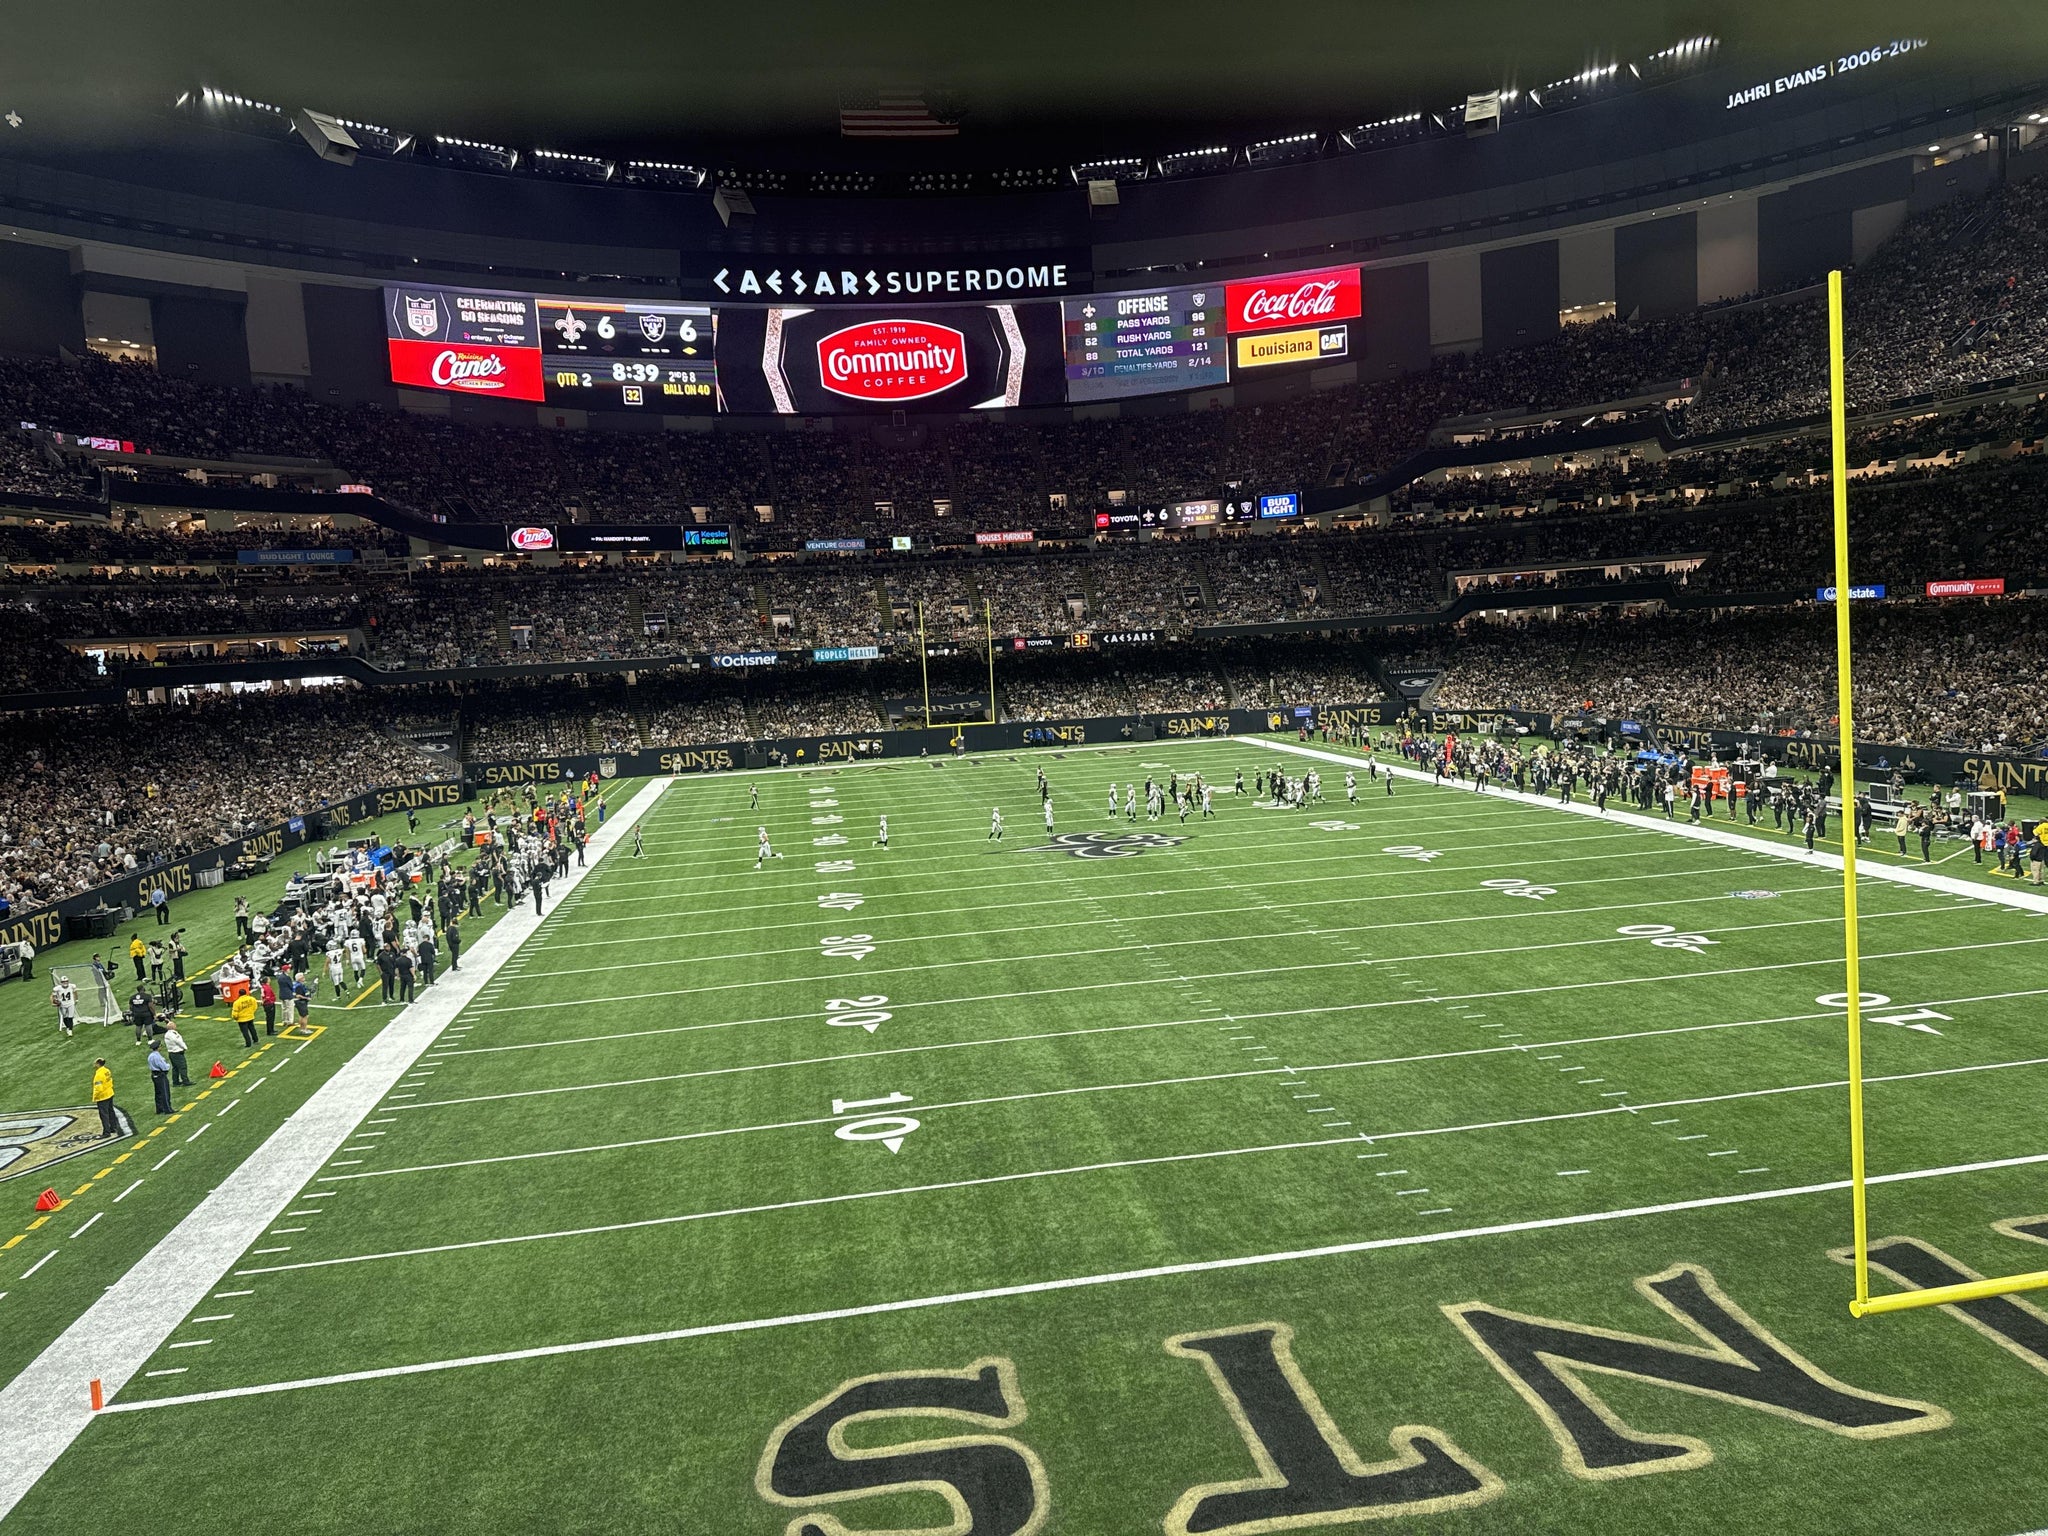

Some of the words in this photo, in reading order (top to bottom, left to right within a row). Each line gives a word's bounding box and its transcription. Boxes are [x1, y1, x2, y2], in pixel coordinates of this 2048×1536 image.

[1726, 82, 1771, 109] JAHRI
[1775, 65, 1827, 94] EVANS
[713, 267, 881, 296] CAESARS
[886, 264, 1067, 294] SUPERDOME
[456, 297, 526, 313] CELEBRATING
[1117, 295, 1169, 315] OFFENSE
[1243, 279, 1341, 323] Coca-Cola
[411, 313, 434, 327] 60
[461, 311, 476, 322] 60
[477, 312, 524, 326] SEASONS
[1117, 319, 1140, 329] PASS
[1141, 315, 1170, 327] YARDS
[597, 315, 616, 339] 6
[679, 319, 697, 342] 6
[873, 327, 888, 335] EST.
[890, 326, 906, 334] 1919
[854, 338, 888, 347] FAMILY
[891, 336, 927, 346] OWNED
[1117, 334, 1142, 344] RUSH
[1143, 331, 1172, 342] YARDS
[1192, 327, 1206, 337] 25
[1321, 332, 1345, 351] CAT
[1116, 349, 1142, 359] TOTAL
[1144, 345, 1174, 356] YARDS
[1191, 341, 1208, 351] 121
[1251, 337, 1313, 358] Louisiana
[431, 350, 506, 386] Cane's
[828, 343, 956, 381] Community
[1188, 356, 1212, 368] 2/14
[612, 362, 660, 382] 8:39
[689, 372, 696, 383] 8
[556, 372, 579, 388] QTR
[582, 373, 593, 387] 2
[863, 376, 927, 388] COFFEE
[626, 389, 640, 401] 32
[663, 383, 684, 395] BALL
[684, 385, 697, 395] ON
[697, 384, 711, 396] 40
[1225, 503, 1235, 514] 6
[1267, 497, 1290, 507] BUD
[1159, 509, 1169, 520] 6
[1184, 504, 1207, 515] 8:39
[1263, 504, 1295, 516] LIGHT
[1110, 514, 1139, 523] TOYOTA
[838, 540, 864, 548] GLOBAL
[940, 535, 967, 543] SAINTS
[976, 534, 1002, 542] ROUSES
[1003, 532, 1033, 540] MARKETS
[0, 549, 30, 558] AINTS
[73, 549, 109, 560] SAINTS
[153, 551, 189, 561] SAINTS
[306, 552, 335, 560] LOUNGE
[1847, 587, 1876, 599] lstate
[1930, 581, 1976, 596] Community
[1074, 634, 1088, 646] 32
[1103, 632, 1155, 643] CAESARS
[1164, 629, 1193, 637] SAINTS
[959, 640, 988, 648] SAINTS
[1026, 638, 1053, 647] TOYOTA
[721, 654, 777, 667] Ochsner
[815, 649, 847, 661] PEOPLES
[849, 647, 877, 659] HEALTH
[904, 700, 982, 713] SAINTS
[1317, 708, 1381, 726] SAINTS
[819, 739, 883, 758] SAINTS
[1786, 741, 1858, 766] SAIN
[660, 750, 730, 770] SAINTS
[485, 763, 560, 784] SAINTS
[1963, 758, 2048, 790] SAINT
[382, 784, 461, 812] SAINTS
[138, 863, 192, 908] SAINTS
[1480, 878, 1558, 899] 30
[0, 909, 61, 948] AINTS
[1615, 924, 1721, 949] 20
[352, 942, 358, 953] 6
[819, 934, 877, 957] 30
[61, 991, 71, 1001] 14
[222, 986, 231, 999] G
[825, 995, 893, 1027] 20
[1815, 992, 1954, 1026] 10
[832, 1092, 921, 1141] 10
